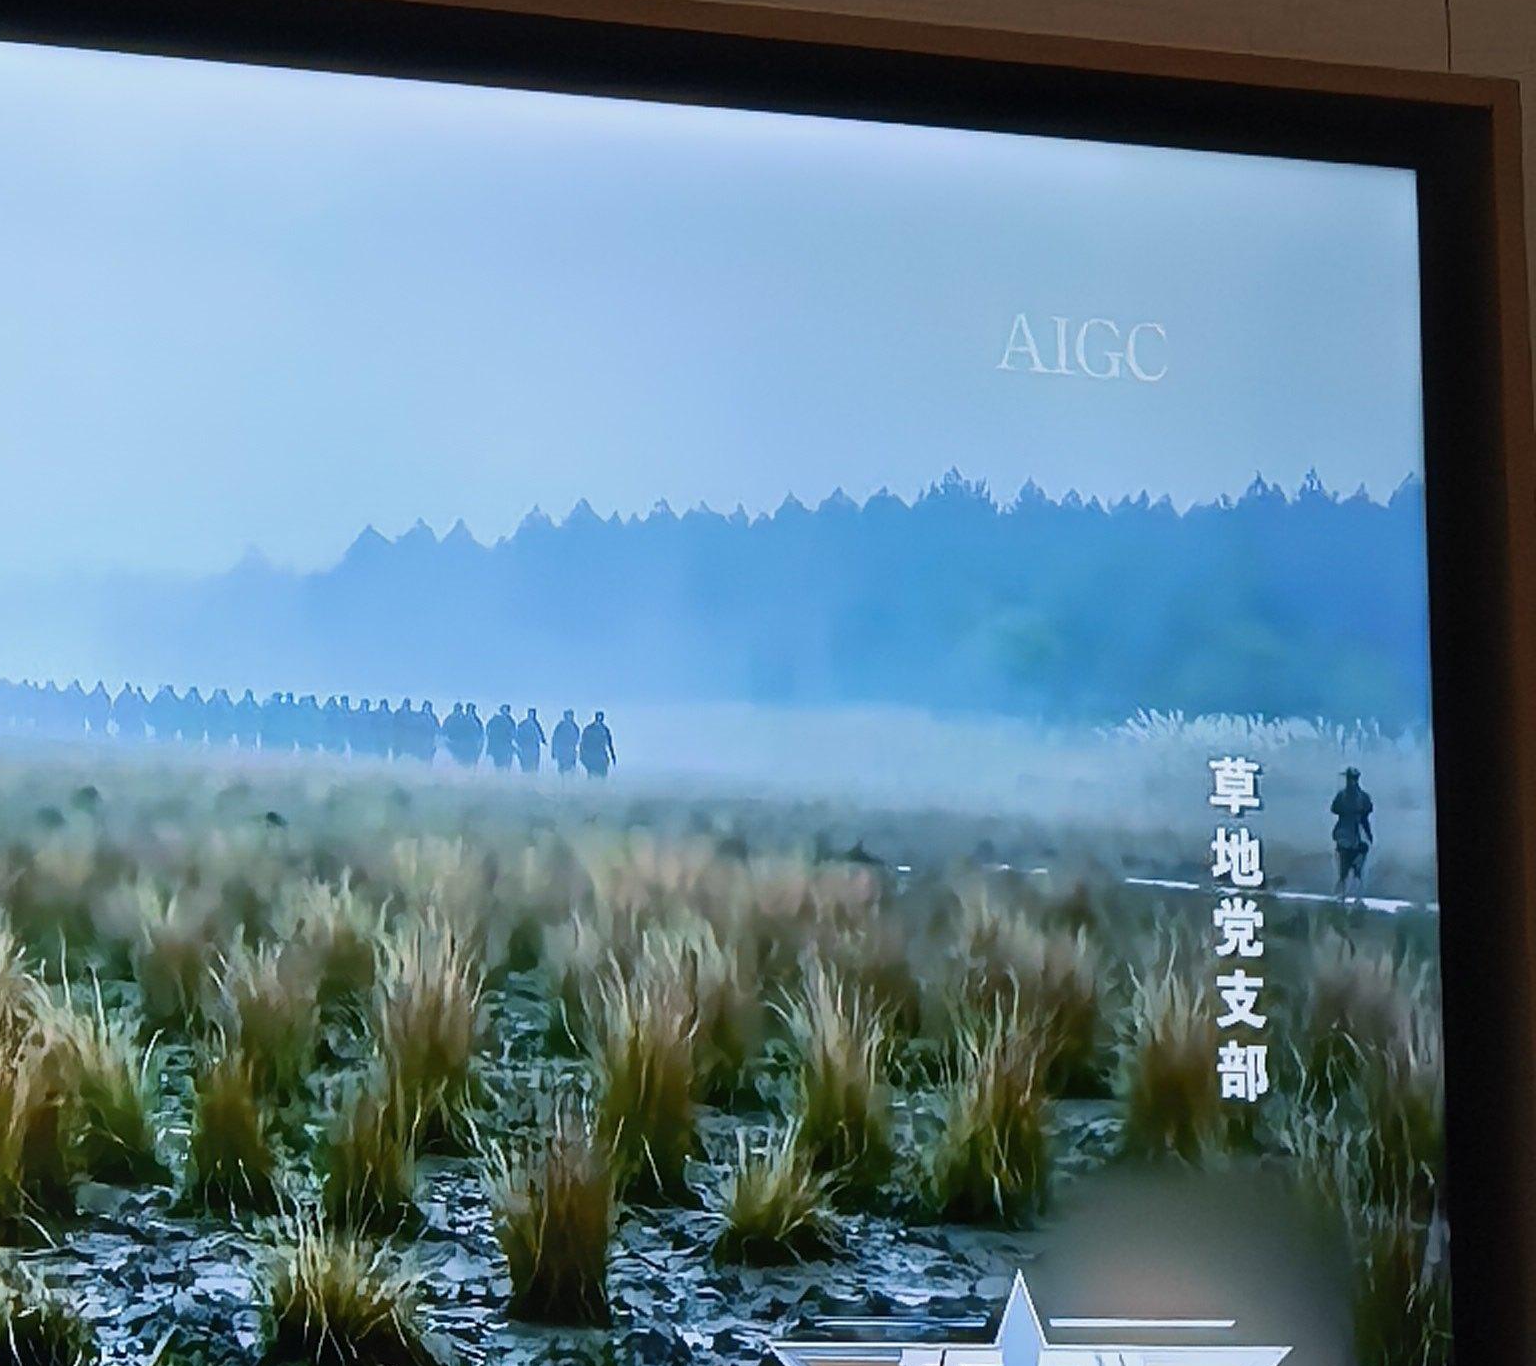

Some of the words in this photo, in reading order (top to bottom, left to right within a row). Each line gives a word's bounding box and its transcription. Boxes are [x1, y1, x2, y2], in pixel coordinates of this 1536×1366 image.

[995, 312, 1169, 382] AIGC
[1208, 755, 1269, 1104] 草地党支部
